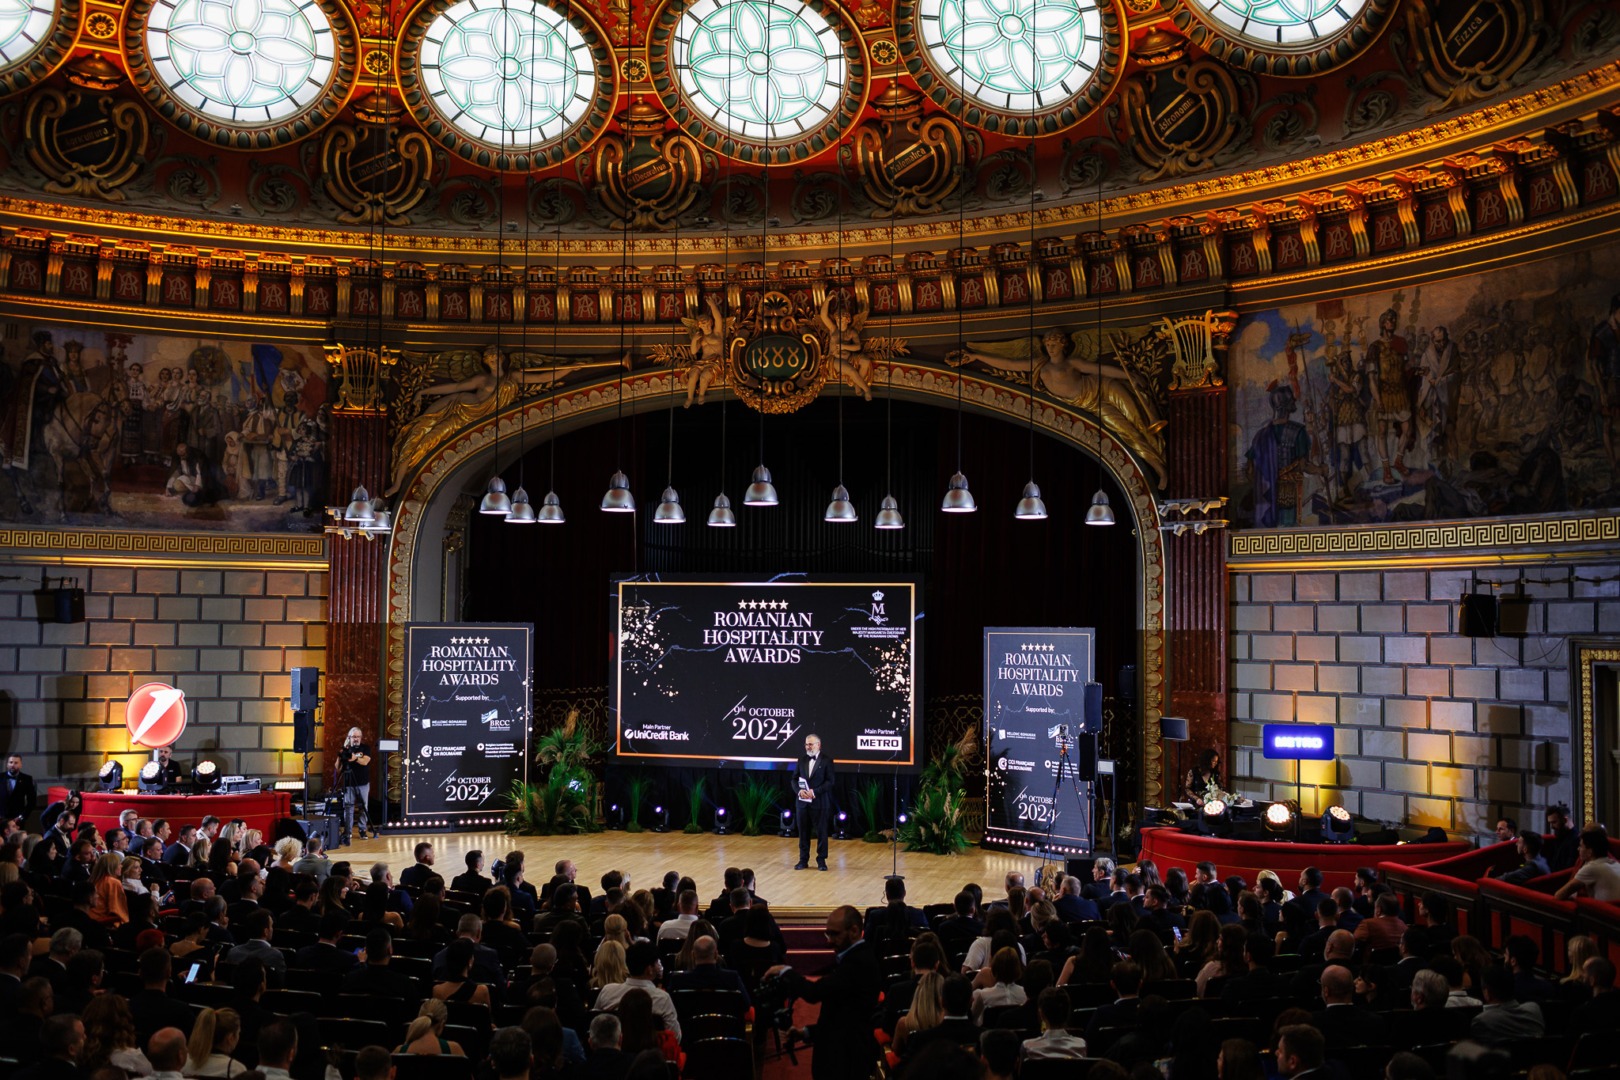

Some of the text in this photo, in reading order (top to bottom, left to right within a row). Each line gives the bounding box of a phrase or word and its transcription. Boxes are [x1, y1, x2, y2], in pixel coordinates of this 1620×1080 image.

[751, 346, 800, 369] 1888
[714, 612, 813, 627] ROMANIAN
[703, 630, 824, 646] HOSPITALITY
[431, 646, 508, 658] ROMANIAN
[724, 648, 801, 663] AWARDS
[1005, 653, 1071, 666] ROMANIAN
[422, 660, 516, 671] HOSPITALITY
[439, 674, 499, 685] AWARDS
[998, 667, 1079, 682] HOSPITALITY
[1012, 682, 1063, 697] AWARDS
[733, 705, 795, 717] 9th OCTOBER
[634, 730, 689, 740] UniCredit Bank
[732, 718, 794, 740] 2024
[860, 739, 899, 747] METRO
[445, 784, 490, 801] 2024
